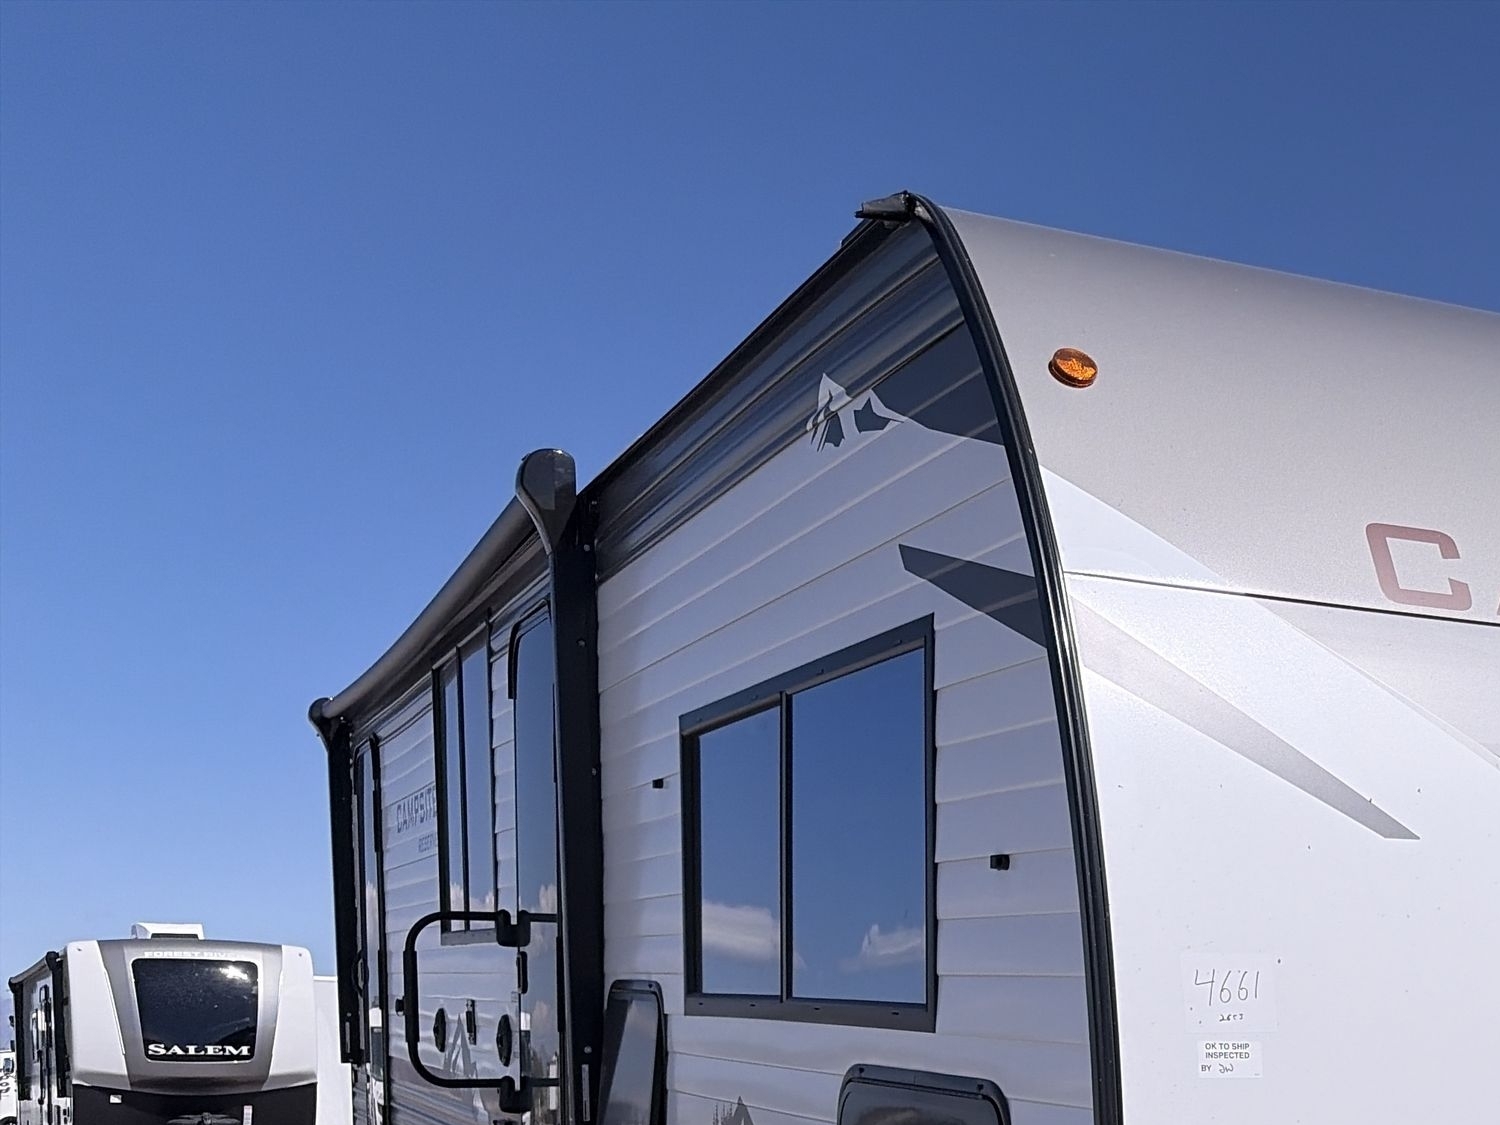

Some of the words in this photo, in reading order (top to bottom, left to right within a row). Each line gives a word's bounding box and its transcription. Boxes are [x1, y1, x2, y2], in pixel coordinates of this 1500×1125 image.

[396, 785, 436, 834] CAMPSITE
[1195, 969, 1259, 1006] 4661
[148, 1043, 251, 1056] SALEM
[1204, 1042, 1217, 1050] OK
[1219, 1042, 1230, 1050] TO
[1231, 1042, 1250, 1050] SHIP
[1205, 1051, 1250, 1059] INSPECTED
[1201, 1064, 1212, 1072] BY
